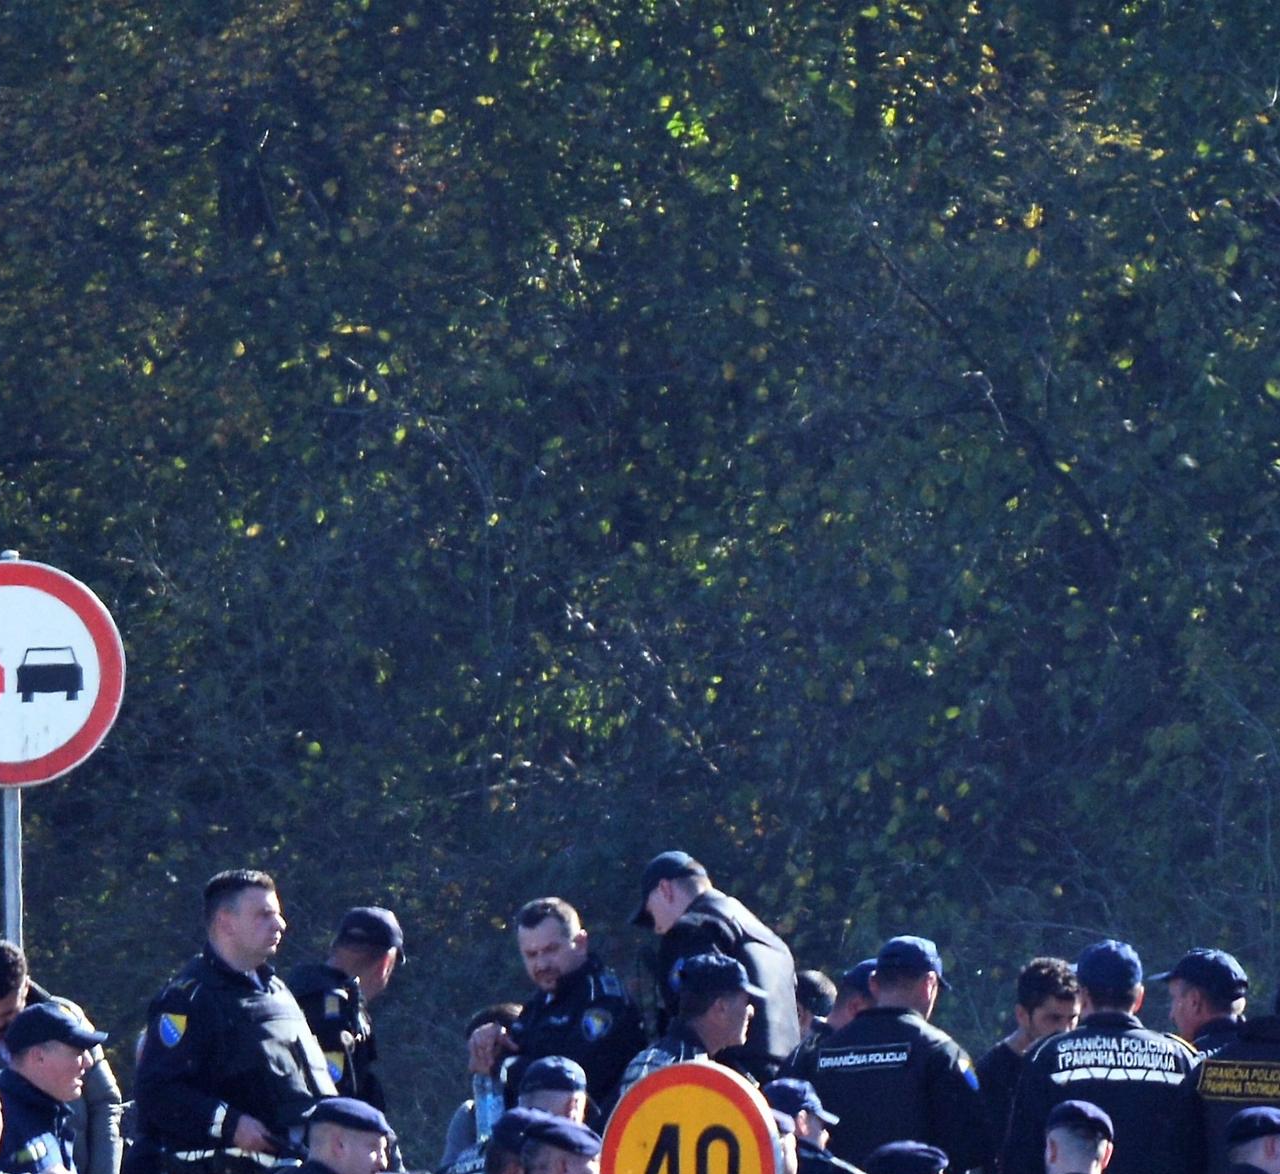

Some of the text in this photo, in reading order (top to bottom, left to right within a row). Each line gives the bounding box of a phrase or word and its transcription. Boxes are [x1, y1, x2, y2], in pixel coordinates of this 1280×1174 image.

[1057, 1034, 1119, 1053] GRANIČNA
[1121, 1037, 1182, 1059] POLICIJA
[820, 1051, 908, 1069] GRANIČNA POLICIJA
[1057, 1050, 1116, 1071] ГРАНИЧНА
[1117, 1051, 1176, 1072] ПОЛИЦИЈА
